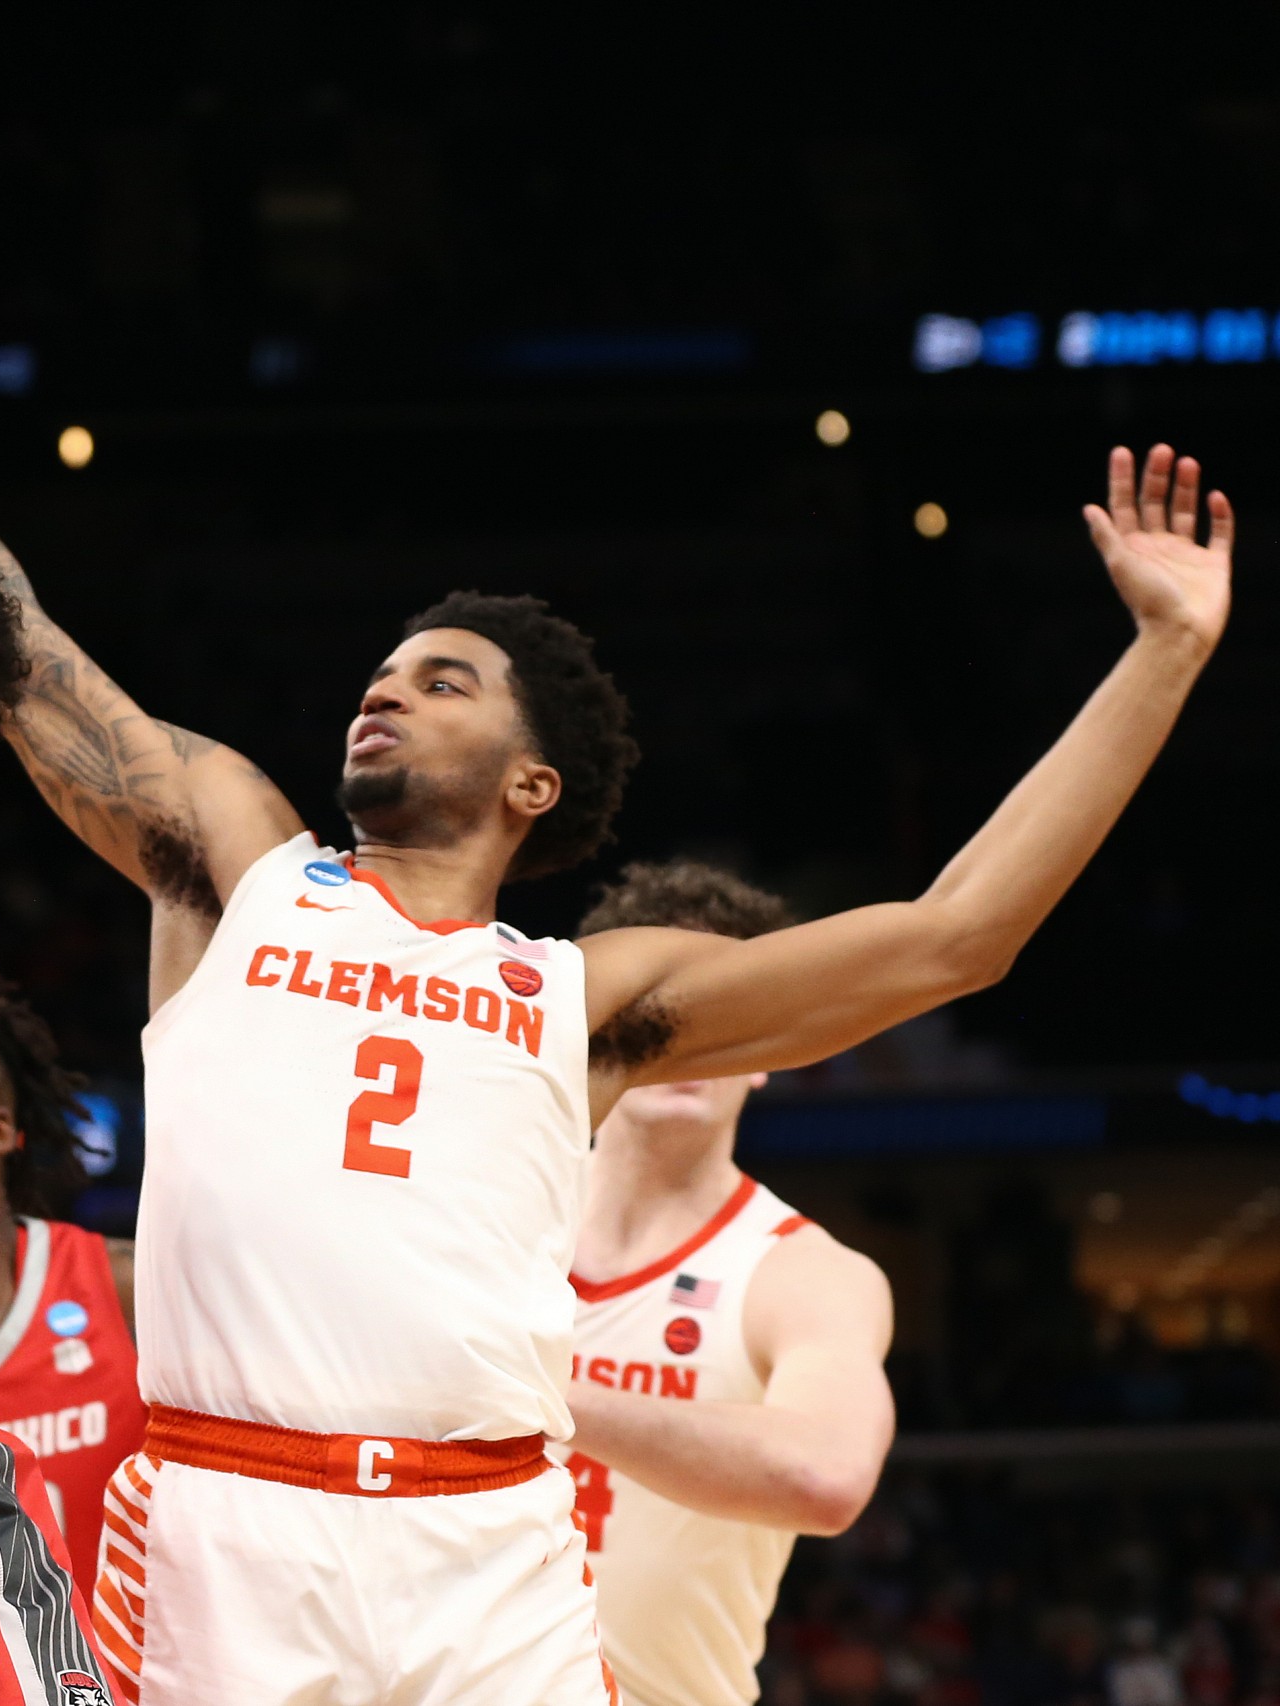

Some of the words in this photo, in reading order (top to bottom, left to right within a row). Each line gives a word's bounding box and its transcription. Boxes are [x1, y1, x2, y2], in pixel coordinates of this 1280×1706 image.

[246, 945, 544, 1058] CLEMSON
[342, 1035, 424, 1179] 2
[571, 1353, 698, 1401] SON
[356, 1439, 394, 1491] C
